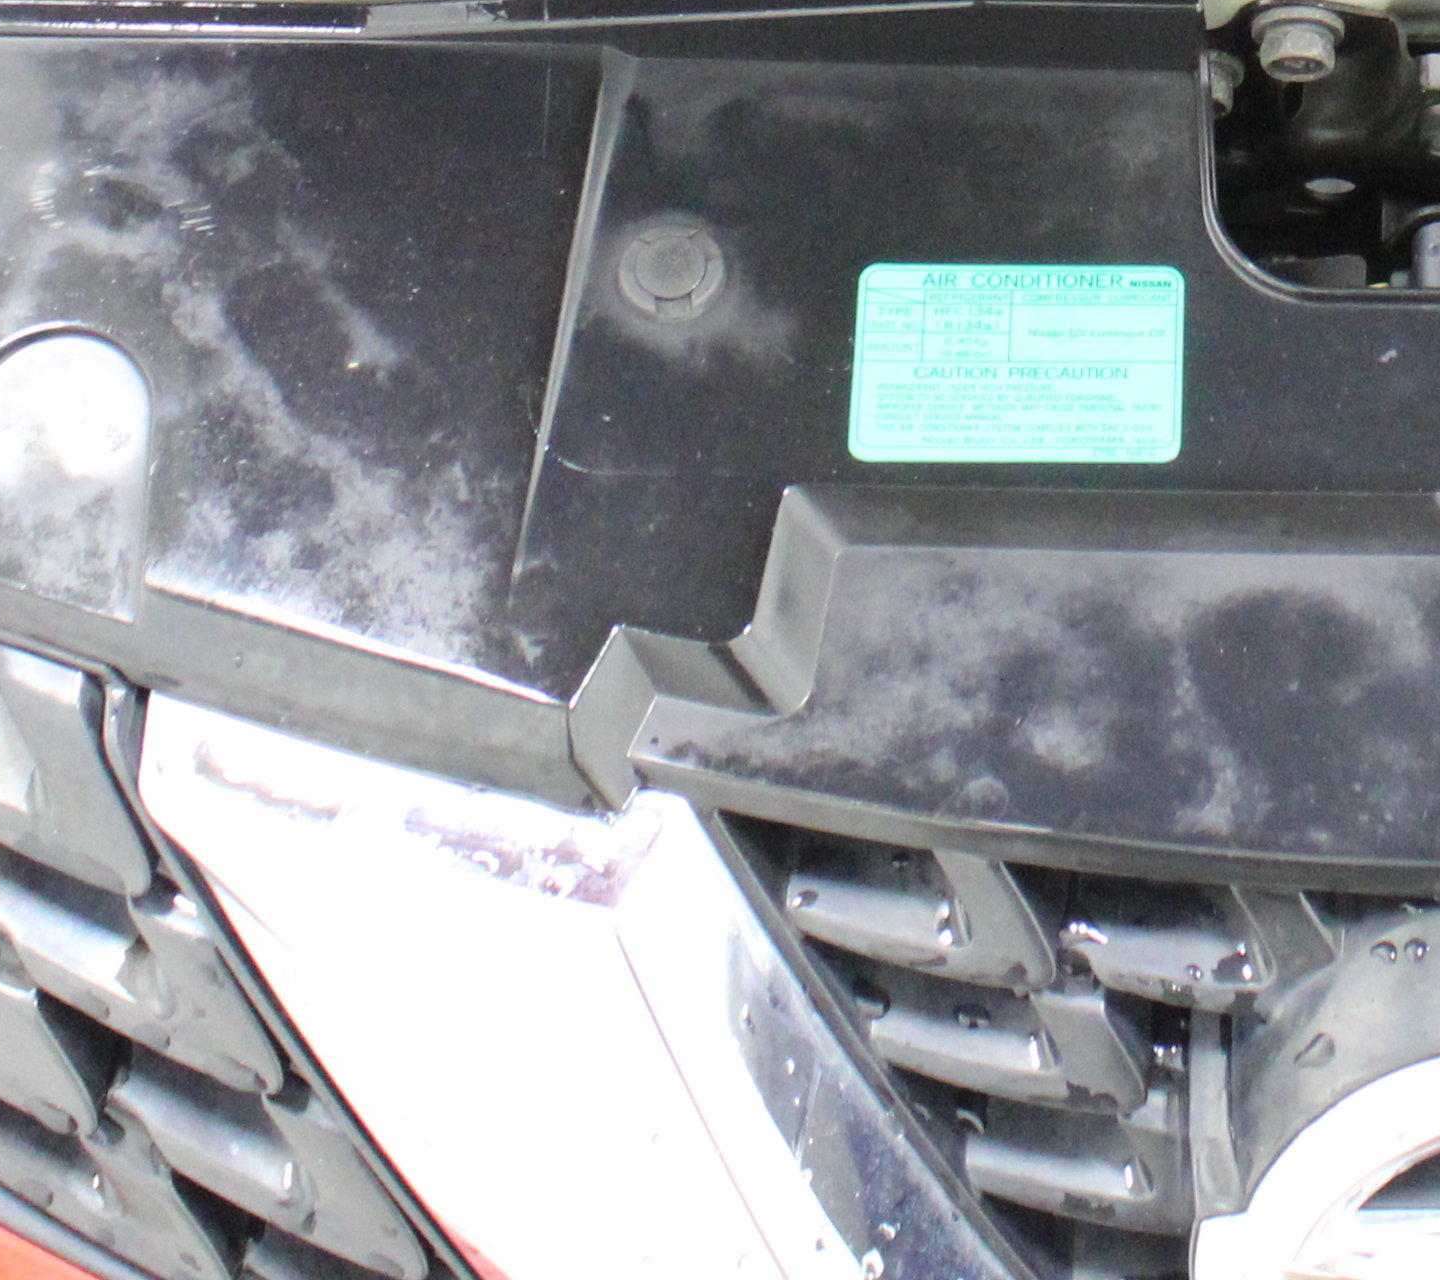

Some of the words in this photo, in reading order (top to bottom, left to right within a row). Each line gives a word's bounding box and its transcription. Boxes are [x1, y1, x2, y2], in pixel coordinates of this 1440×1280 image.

[922, 272, 958, 288] AIR
[971, 272, 1124, 289] CONDITIONER
[1128, 278, 1173, 288] NISSAN
[929, 292, 1010, 303] REFRIGERANT
[877, 305, 912, 317] TYPE
[913, 366, 998, 380] CAUTION
